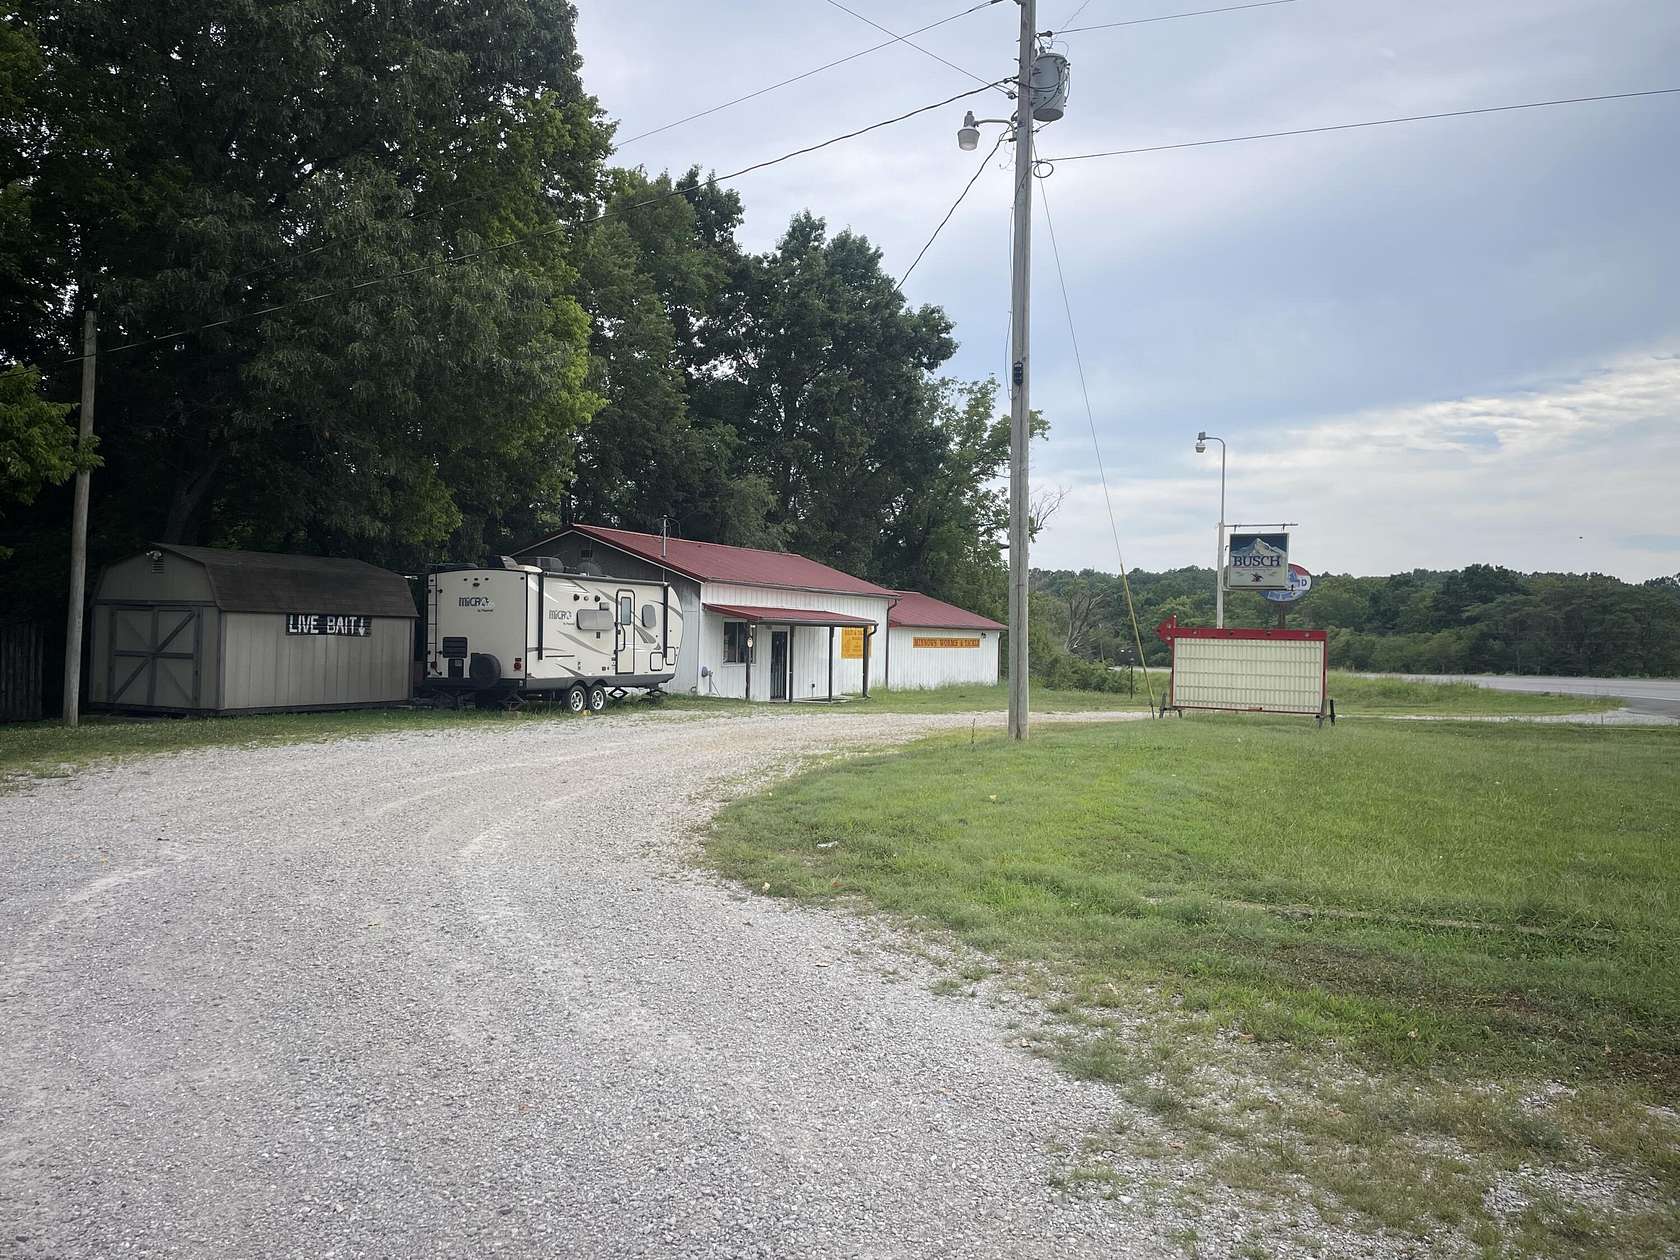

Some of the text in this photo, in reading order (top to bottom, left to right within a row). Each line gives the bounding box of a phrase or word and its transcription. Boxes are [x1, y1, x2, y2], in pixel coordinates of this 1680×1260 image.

[1232, 555, 1281, 567] BUSCH
[289, 615, 357, 634] LIVE BAIT
